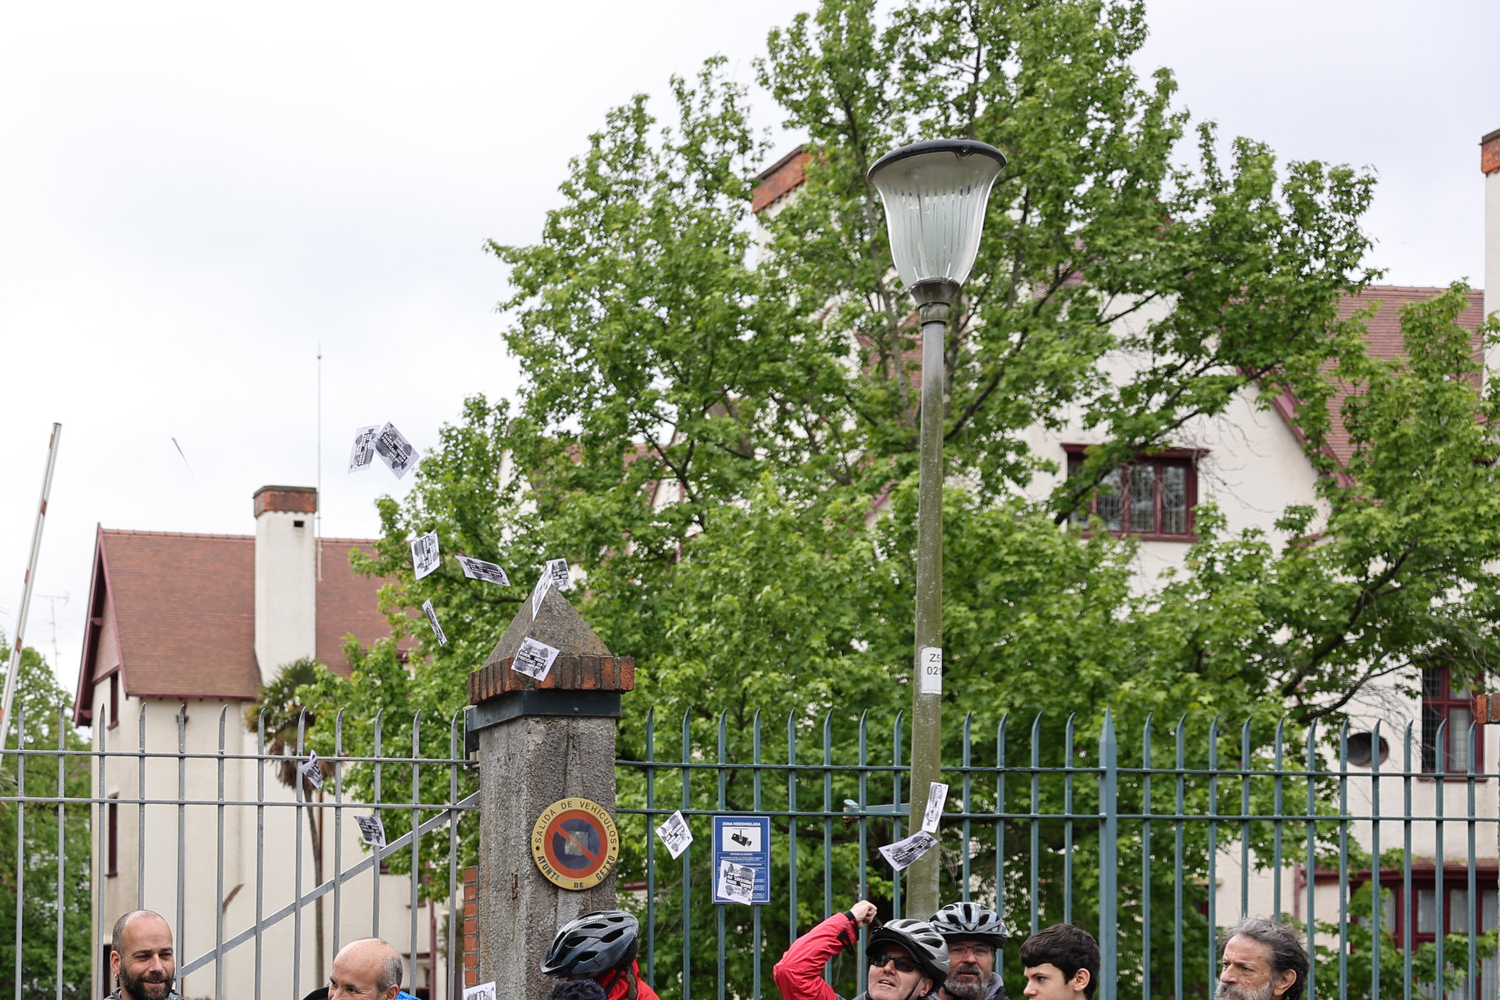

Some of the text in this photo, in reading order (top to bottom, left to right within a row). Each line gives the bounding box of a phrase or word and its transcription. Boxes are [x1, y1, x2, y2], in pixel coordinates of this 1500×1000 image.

[534, 800, 618, 845] SALIDA DE VEHICULOS
[595, 854, 617, 882] GETXO
